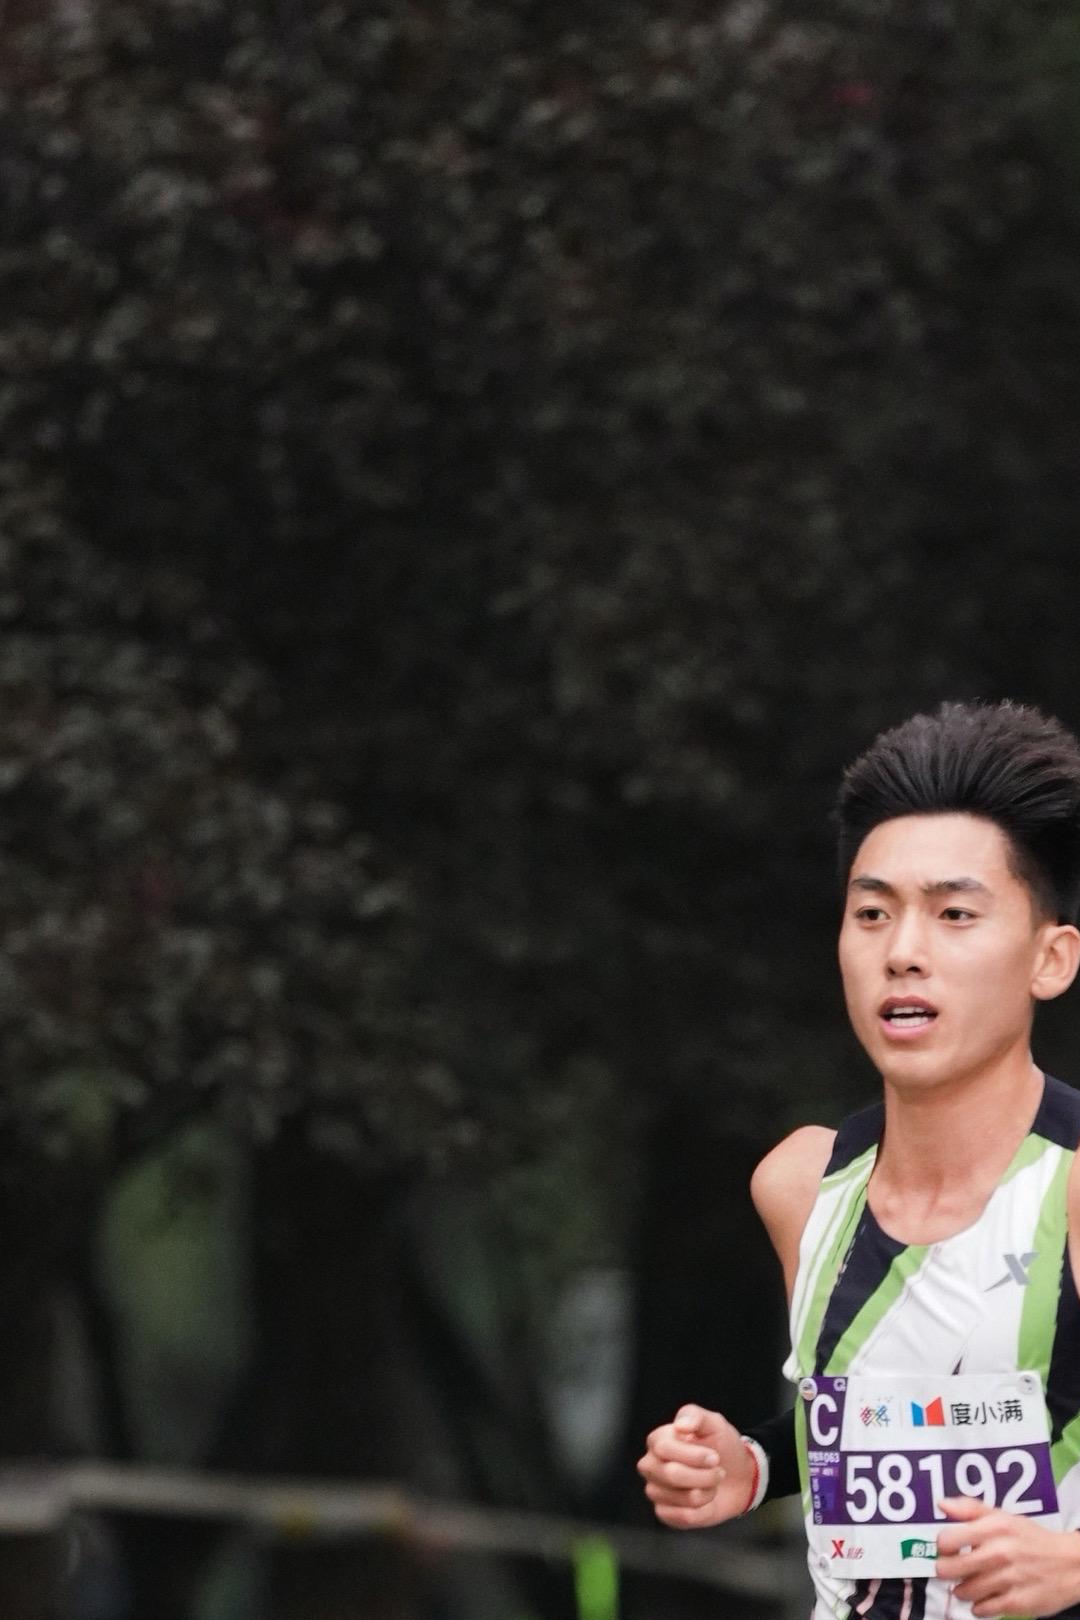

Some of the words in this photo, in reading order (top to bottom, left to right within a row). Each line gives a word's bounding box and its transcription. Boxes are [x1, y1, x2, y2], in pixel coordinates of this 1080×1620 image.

[810, 1394, 838, 1446] C
[950, 1400, 1024, 1426] 度小满
[846, 1449, 1043, 1522] 58192
